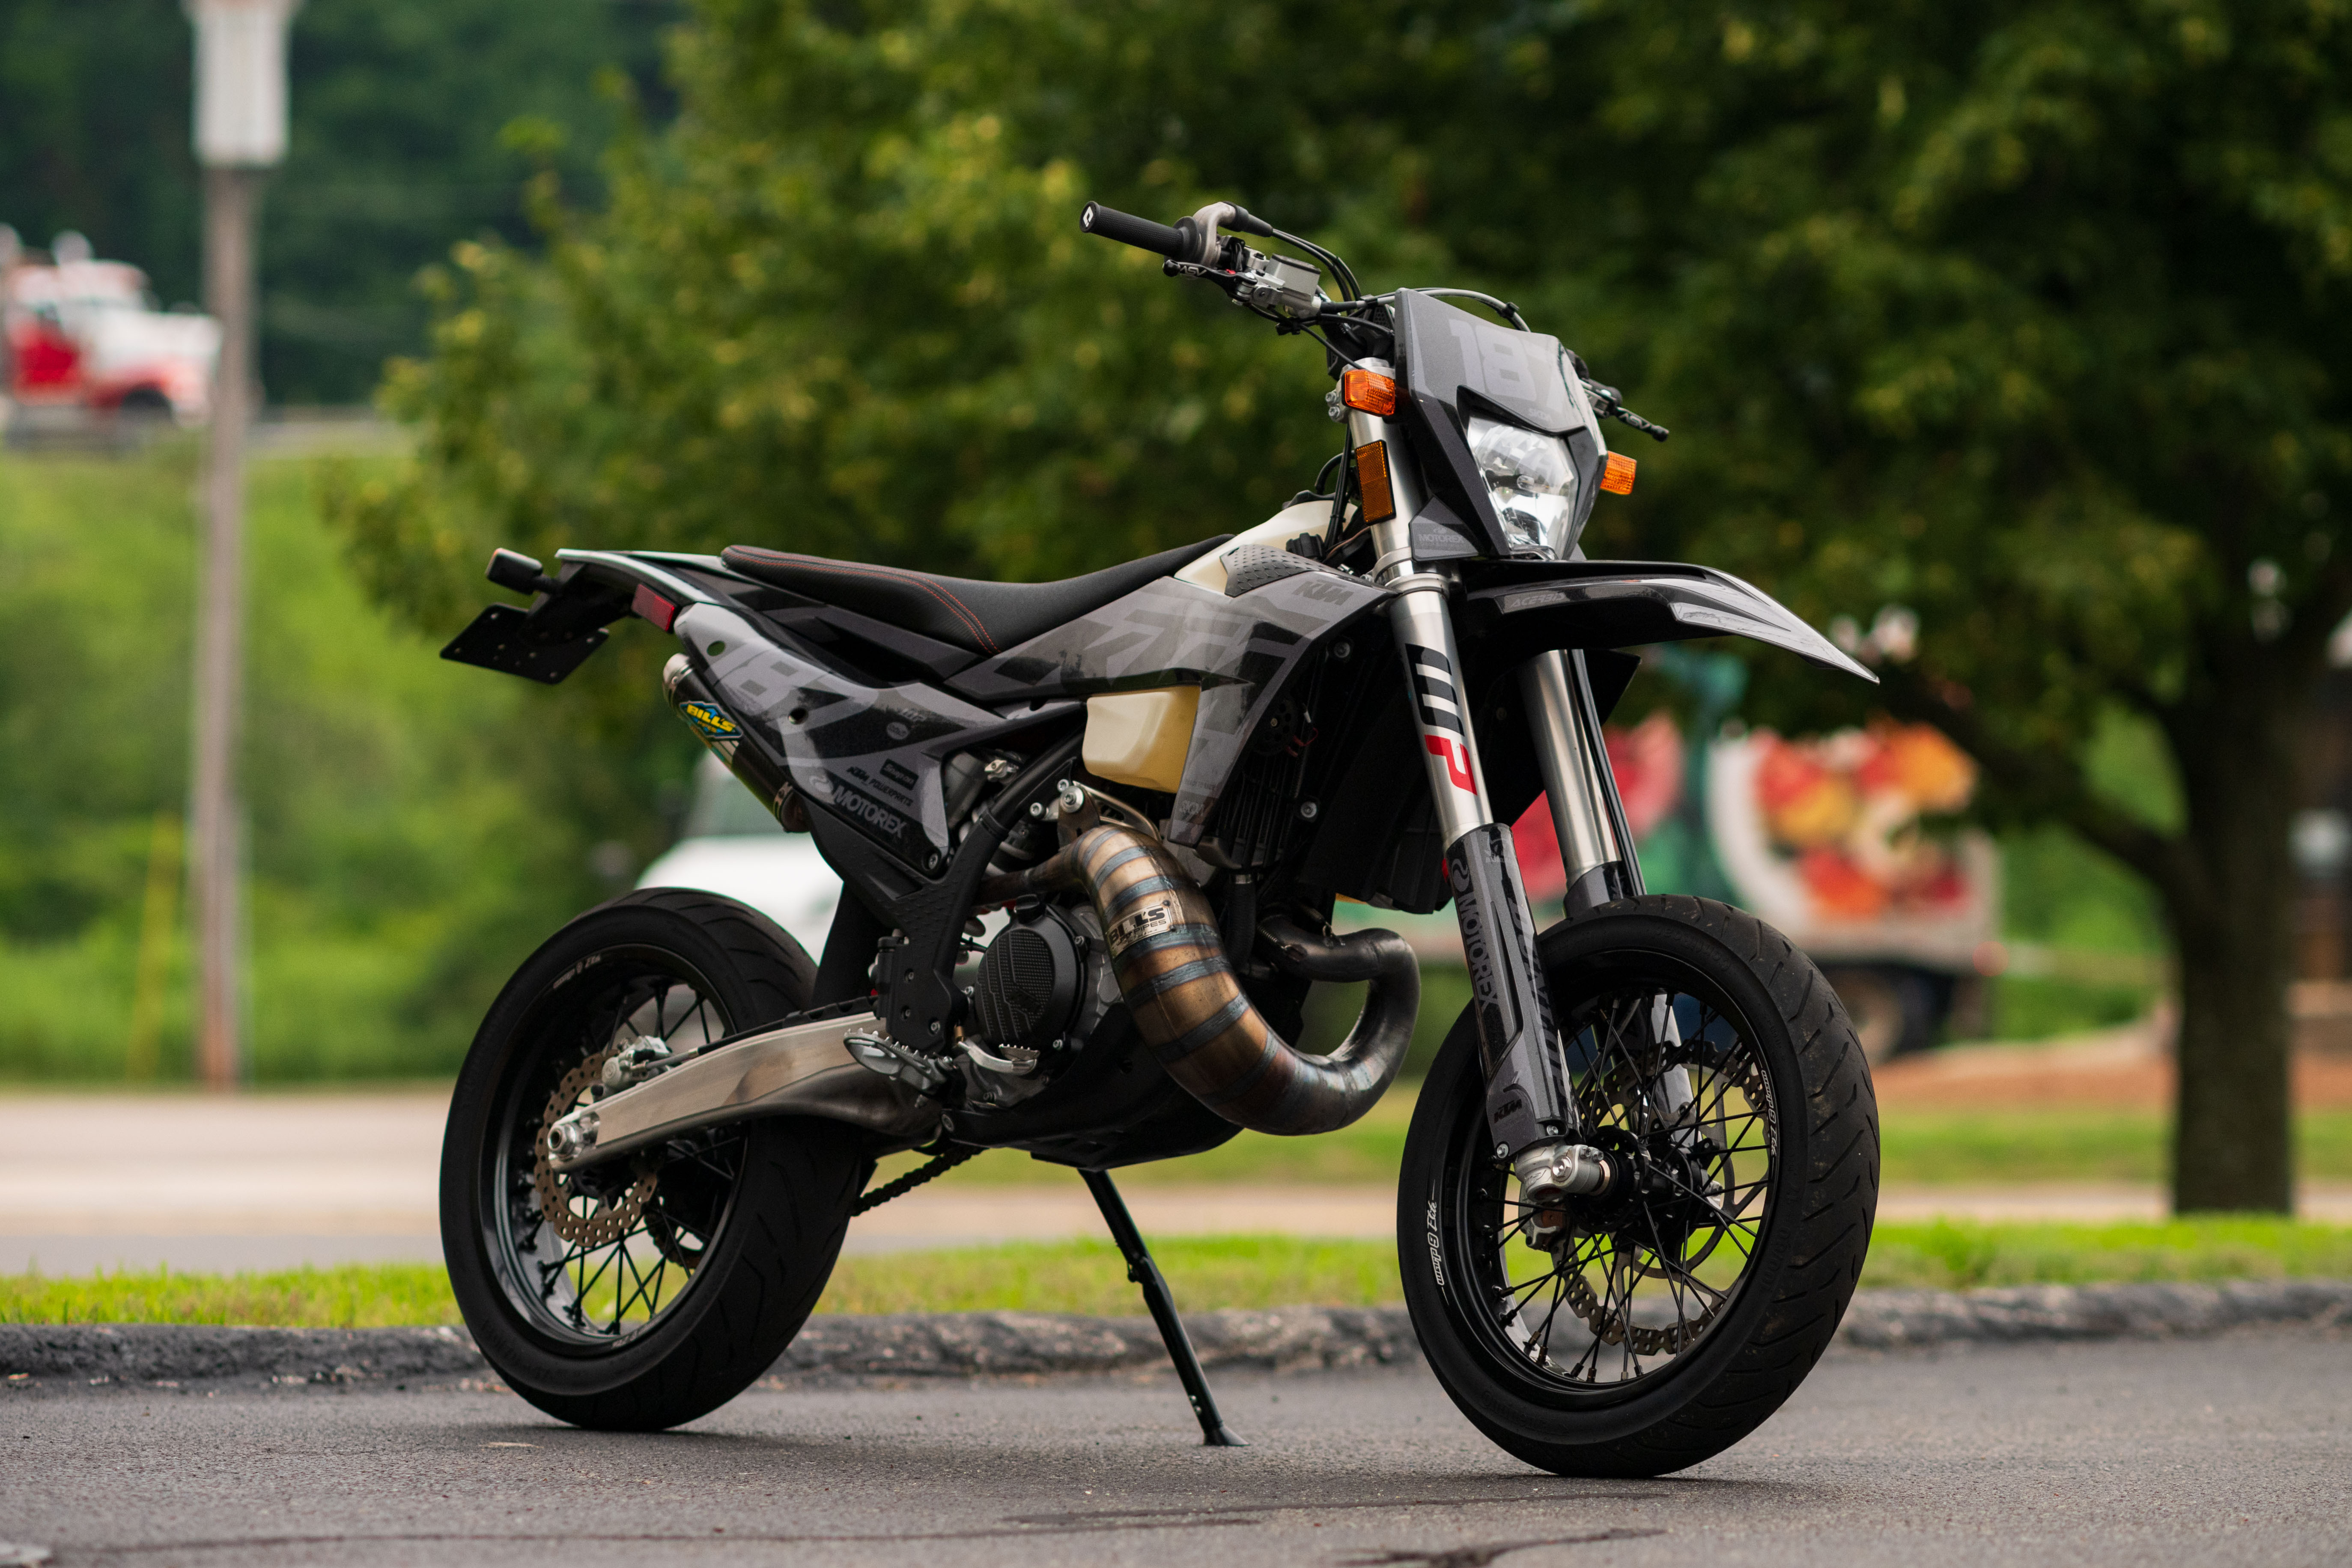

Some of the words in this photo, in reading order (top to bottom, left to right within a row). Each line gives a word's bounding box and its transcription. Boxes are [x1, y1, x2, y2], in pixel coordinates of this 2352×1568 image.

[1180, 265, 1207, 276] ASV
[1418, 534, 1465, 543] MOTOREX
[1291, 579, 1355, 606] KTM
[687, 704, 736, 732] BILL'S
[831, 783, 908, 839] MOTOREX
[1133, 919, 1166, 935] PIPES
[1457, 892, 1499, 1011] MOTOREX
[1508, 897, 1570, 1098] DUNLOP
[1493, 1097, 1523, 1124] KTM
[1427, 1200, 1437, 1232] Elite
